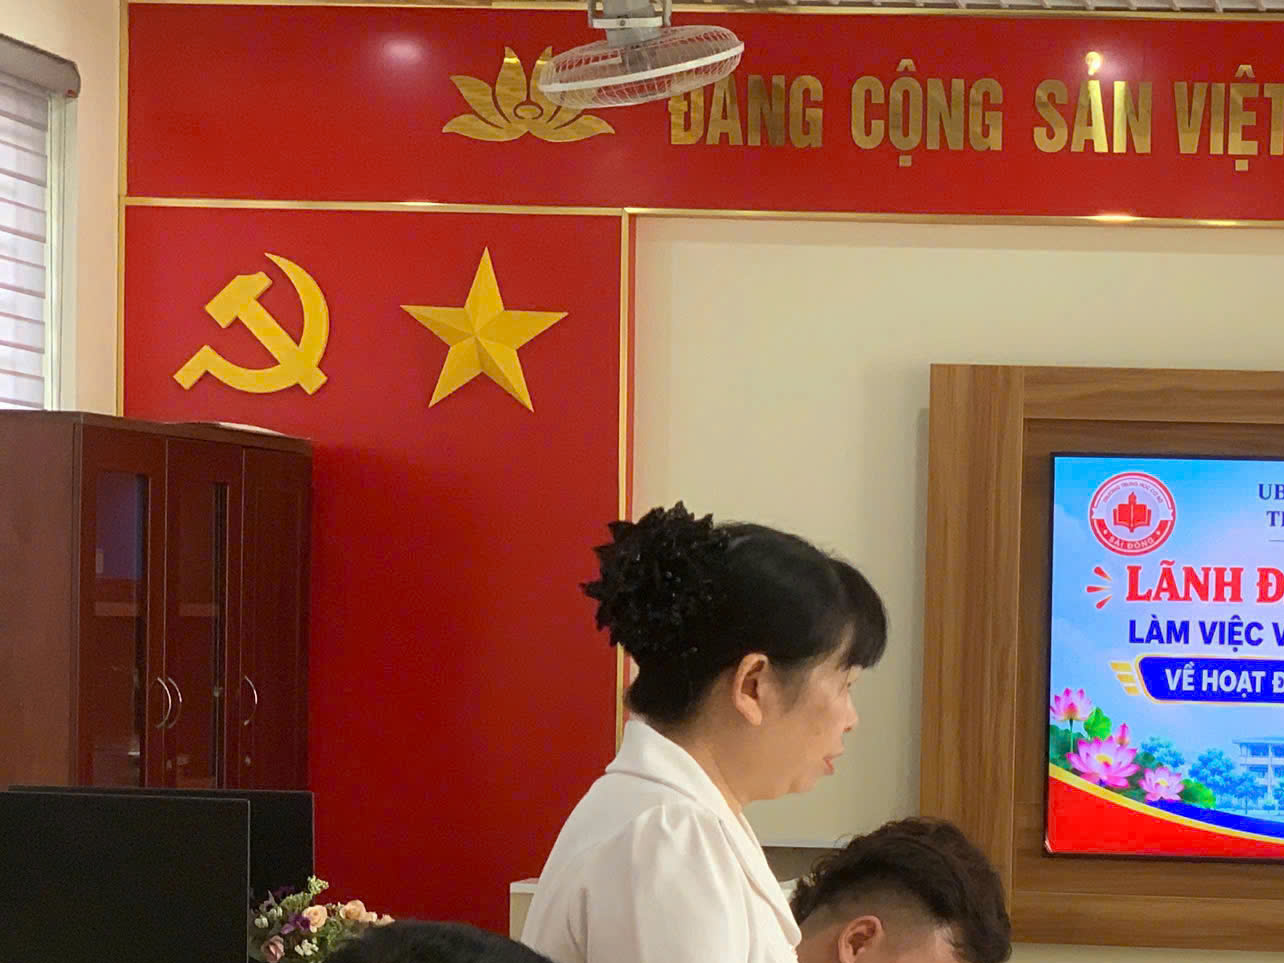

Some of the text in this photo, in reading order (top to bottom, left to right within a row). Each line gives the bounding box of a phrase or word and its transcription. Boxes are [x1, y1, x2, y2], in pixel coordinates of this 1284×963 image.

[851, 58, 1003, 168] CỘNG
[1033, 50, 1153, 155] SẢN
[1125, 560, 1244, 602] LÃNH
[1128, 614, 1190, 644] LÀM
[1198, 614, 1264, 653] VIỆC
[1165, 661, 1196, 691] VỀ
[1202, 668, 1265, 699] HOẠT
